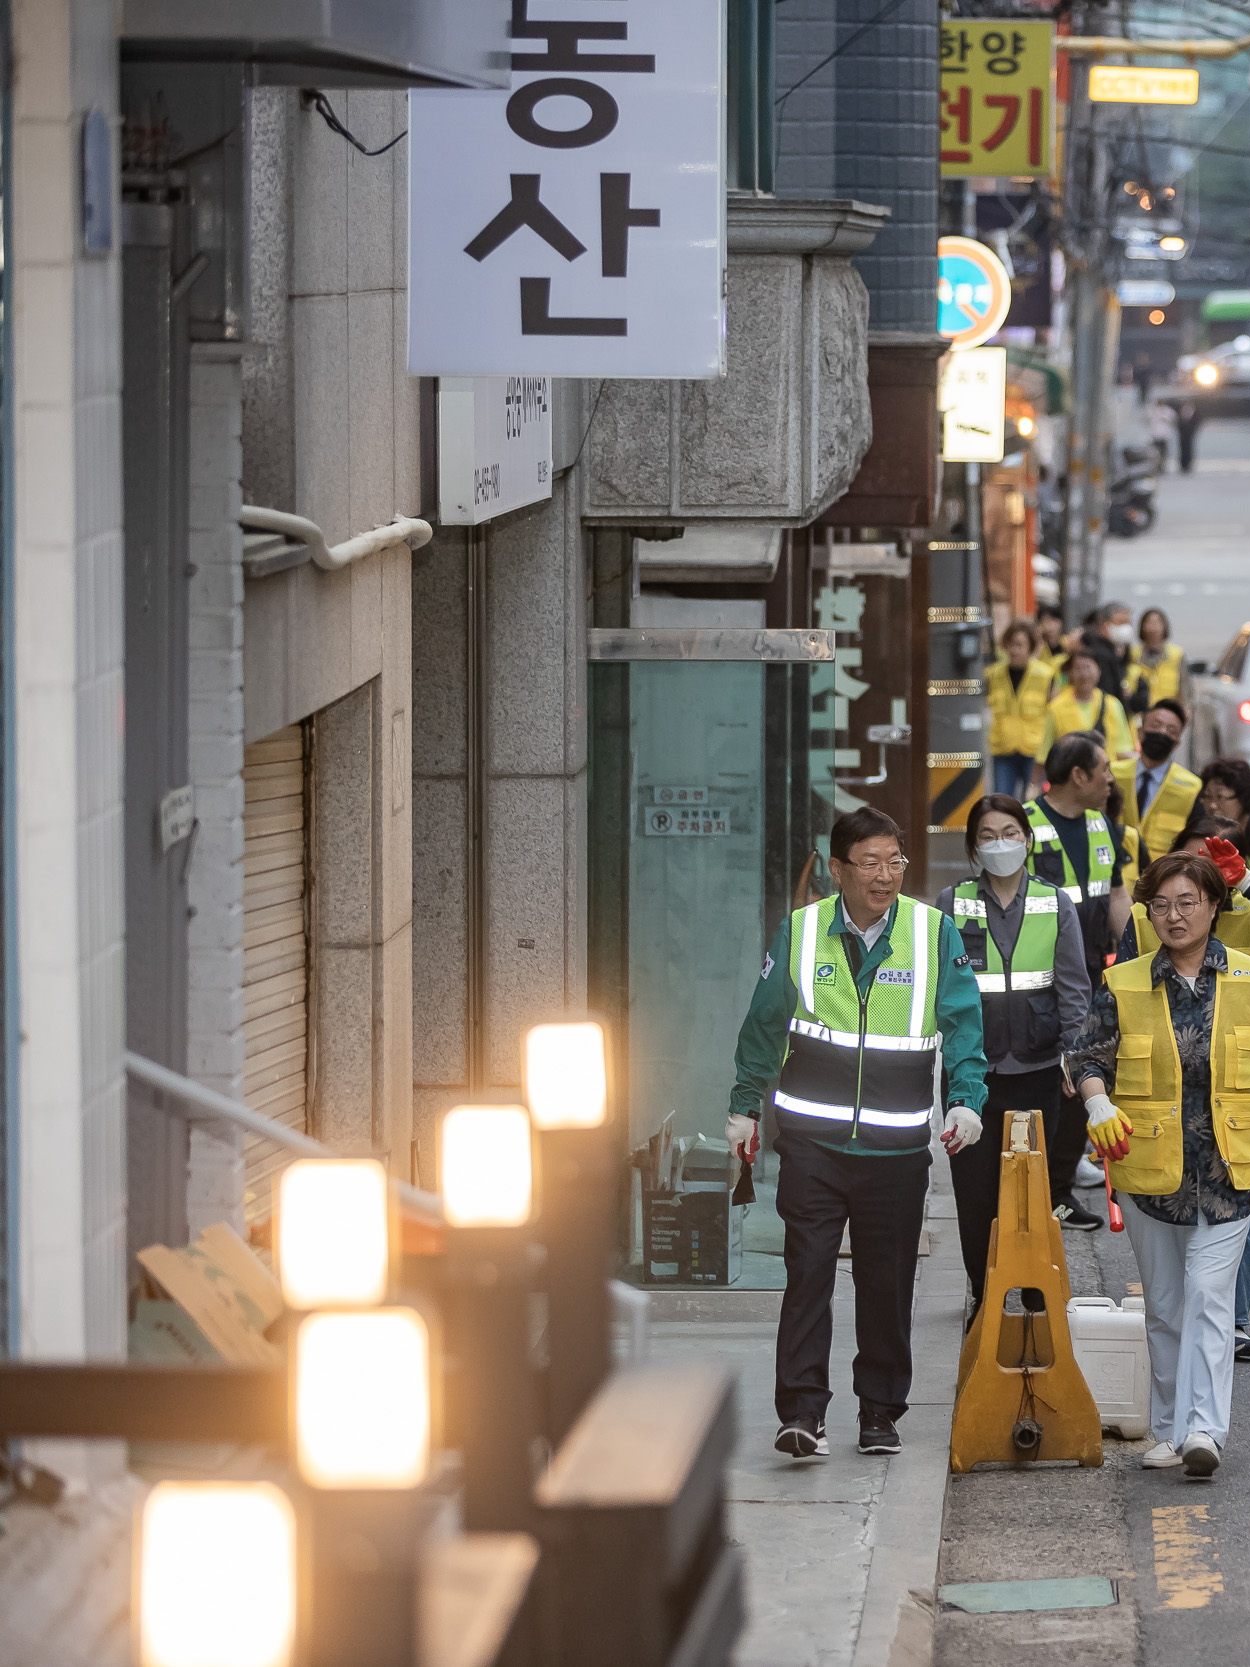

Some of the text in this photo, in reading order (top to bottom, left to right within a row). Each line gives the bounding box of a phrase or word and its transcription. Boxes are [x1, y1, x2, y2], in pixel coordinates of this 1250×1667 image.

[940, 29, 1026, 76] 한양
[939, 86, 1043, 167] 전기
[464, 0, 660, 337] 동산
